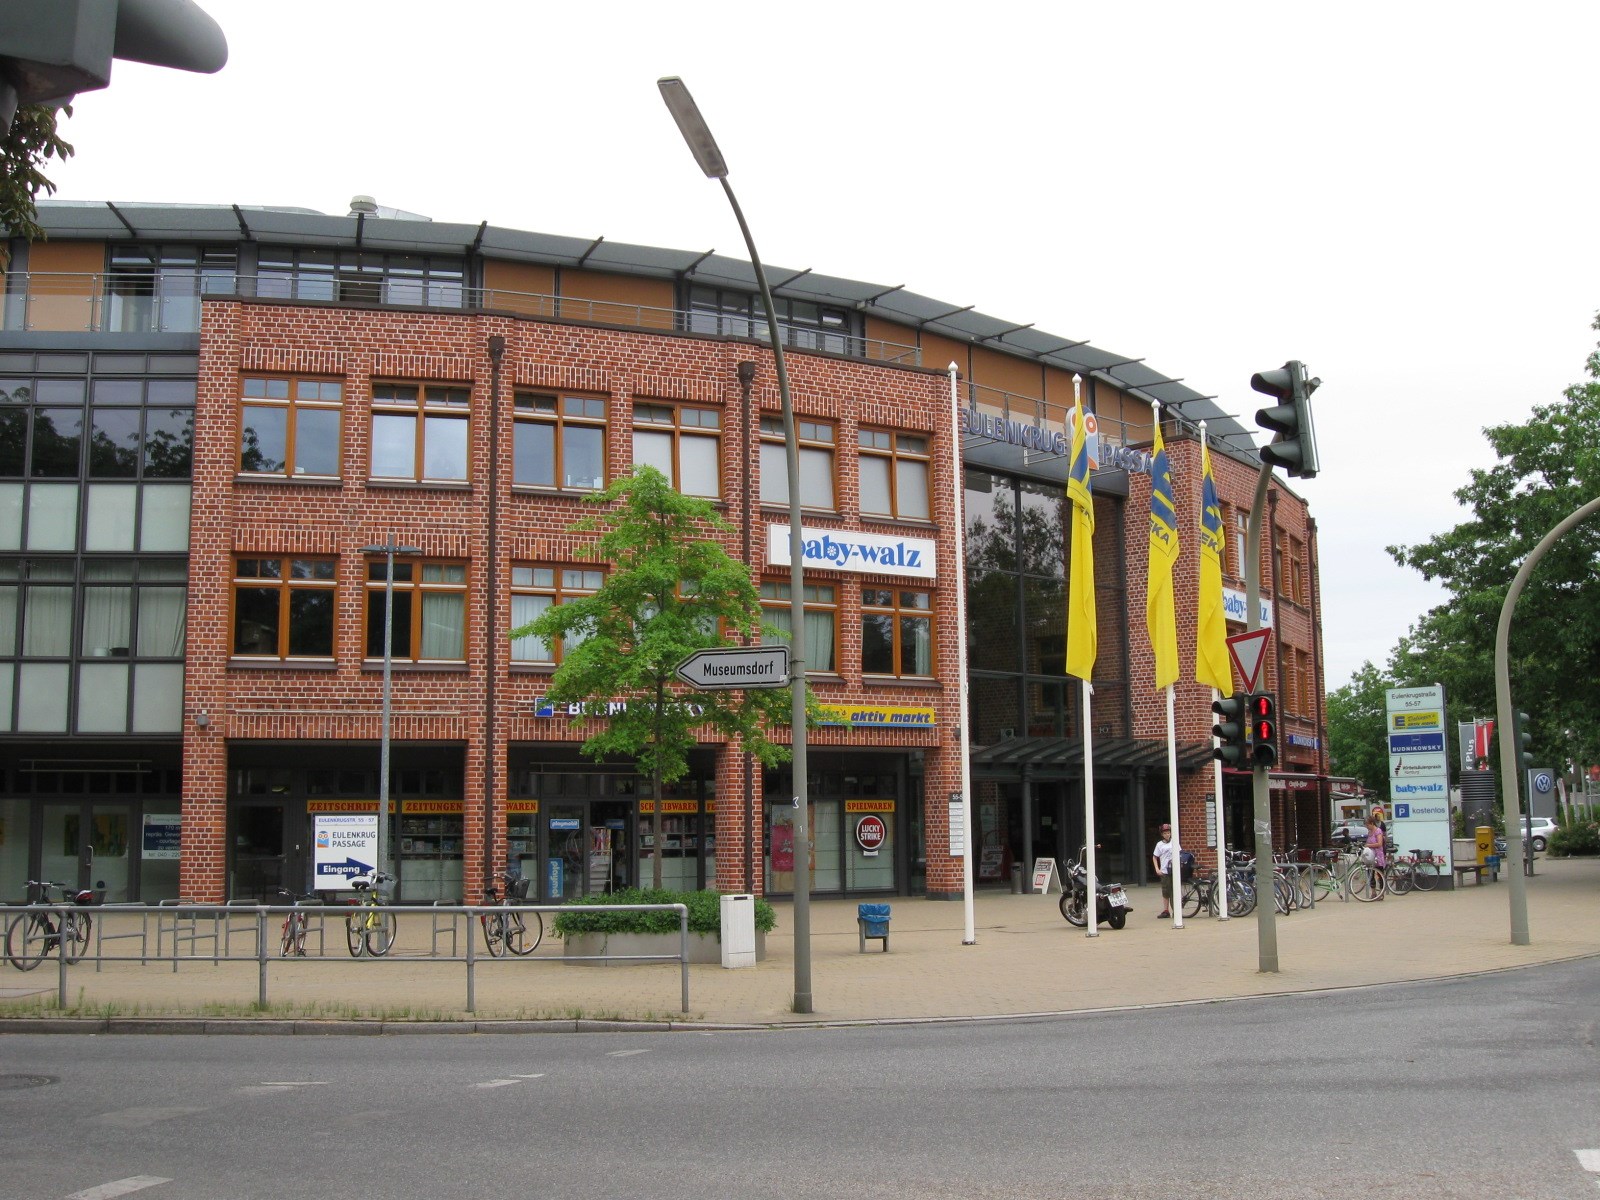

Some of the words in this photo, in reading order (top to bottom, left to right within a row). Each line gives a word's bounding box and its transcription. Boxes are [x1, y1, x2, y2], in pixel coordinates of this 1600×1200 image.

[962, 408, 1065, 455] EULENKRUG
[1222, 591, 1268, 621] aby-lz
[703, 661, 774, 676] Museumsdorf
[1392, 692, 1436, 700] Eulenkrugstraße
[851, 710, 886, 722] aktiv
[890, 712, 931, 724] markt
[1466, 739, 1474, 763] Plus
[1396, 784, 1444, 793] baby-walz
[309, 802, 394, 811] ZEITSCHRIFTN
[406, 802, 464, 810] ZEITUNGEN
[847, 802, 892, 810] SPIELWAREN
[861, 824, 880, 832] LUCKY
[860, 832, 881, 840] STRIKE
[323, 865, 360, 874] Eingang
